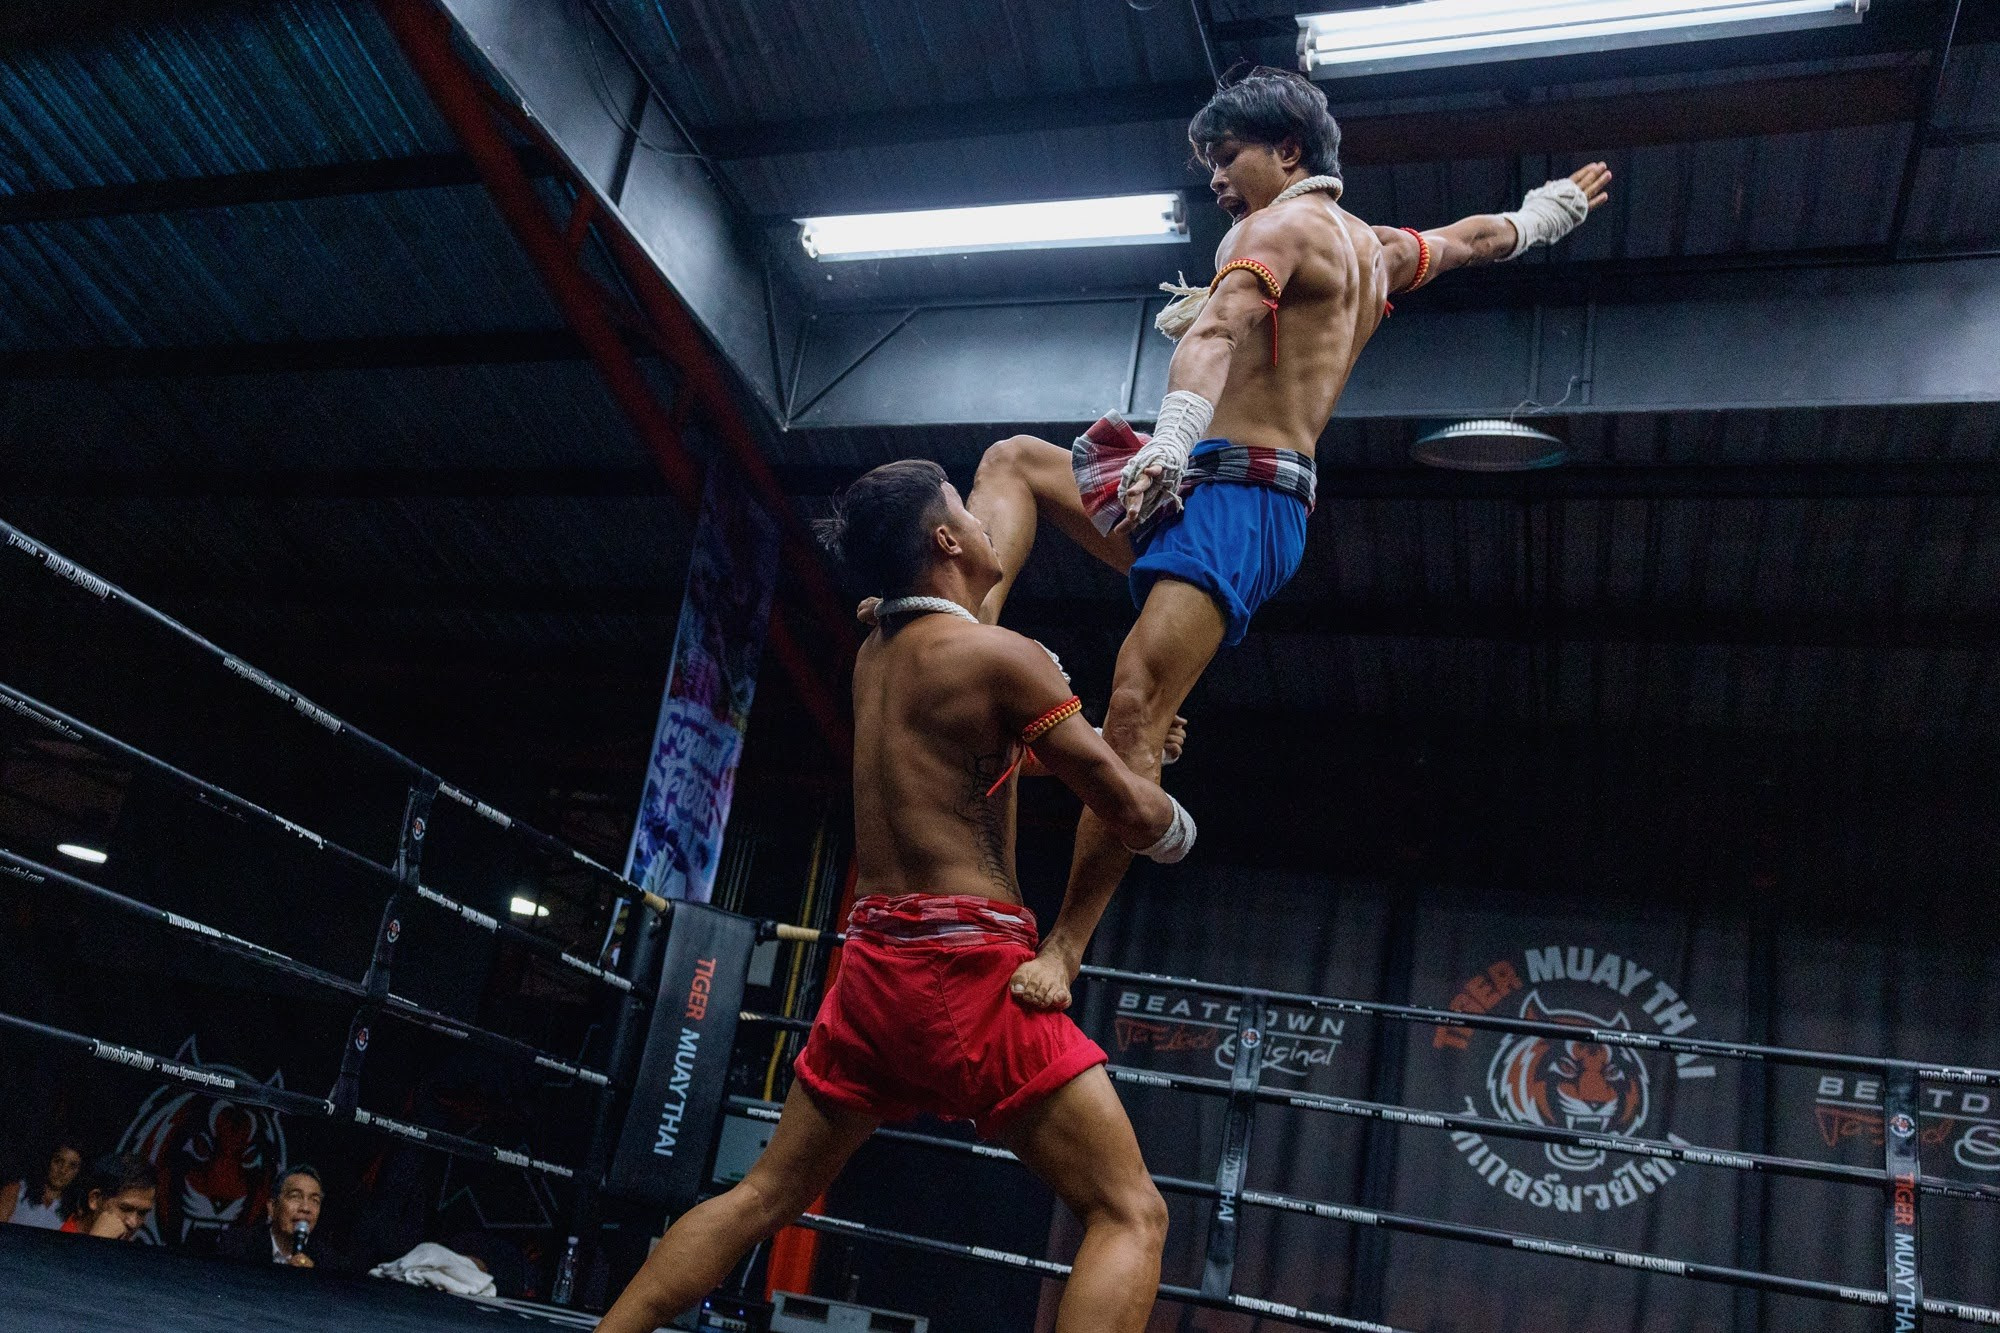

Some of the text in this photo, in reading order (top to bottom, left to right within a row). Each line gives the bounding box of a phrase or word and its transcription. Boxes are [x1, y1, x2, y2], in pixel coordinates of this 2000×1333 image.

[685, 958, 717, 1021] TIGER
[1524, 946, 1653, 998] MUAY
[162, 1063, 236, 1090] www.tigermuaythai.com
[1214, 1033, 1338, 1077] Oiginal
[1817, 1075, 1991, 1114] BETD
[1895, 1173, 1916, 1226] TIGER
